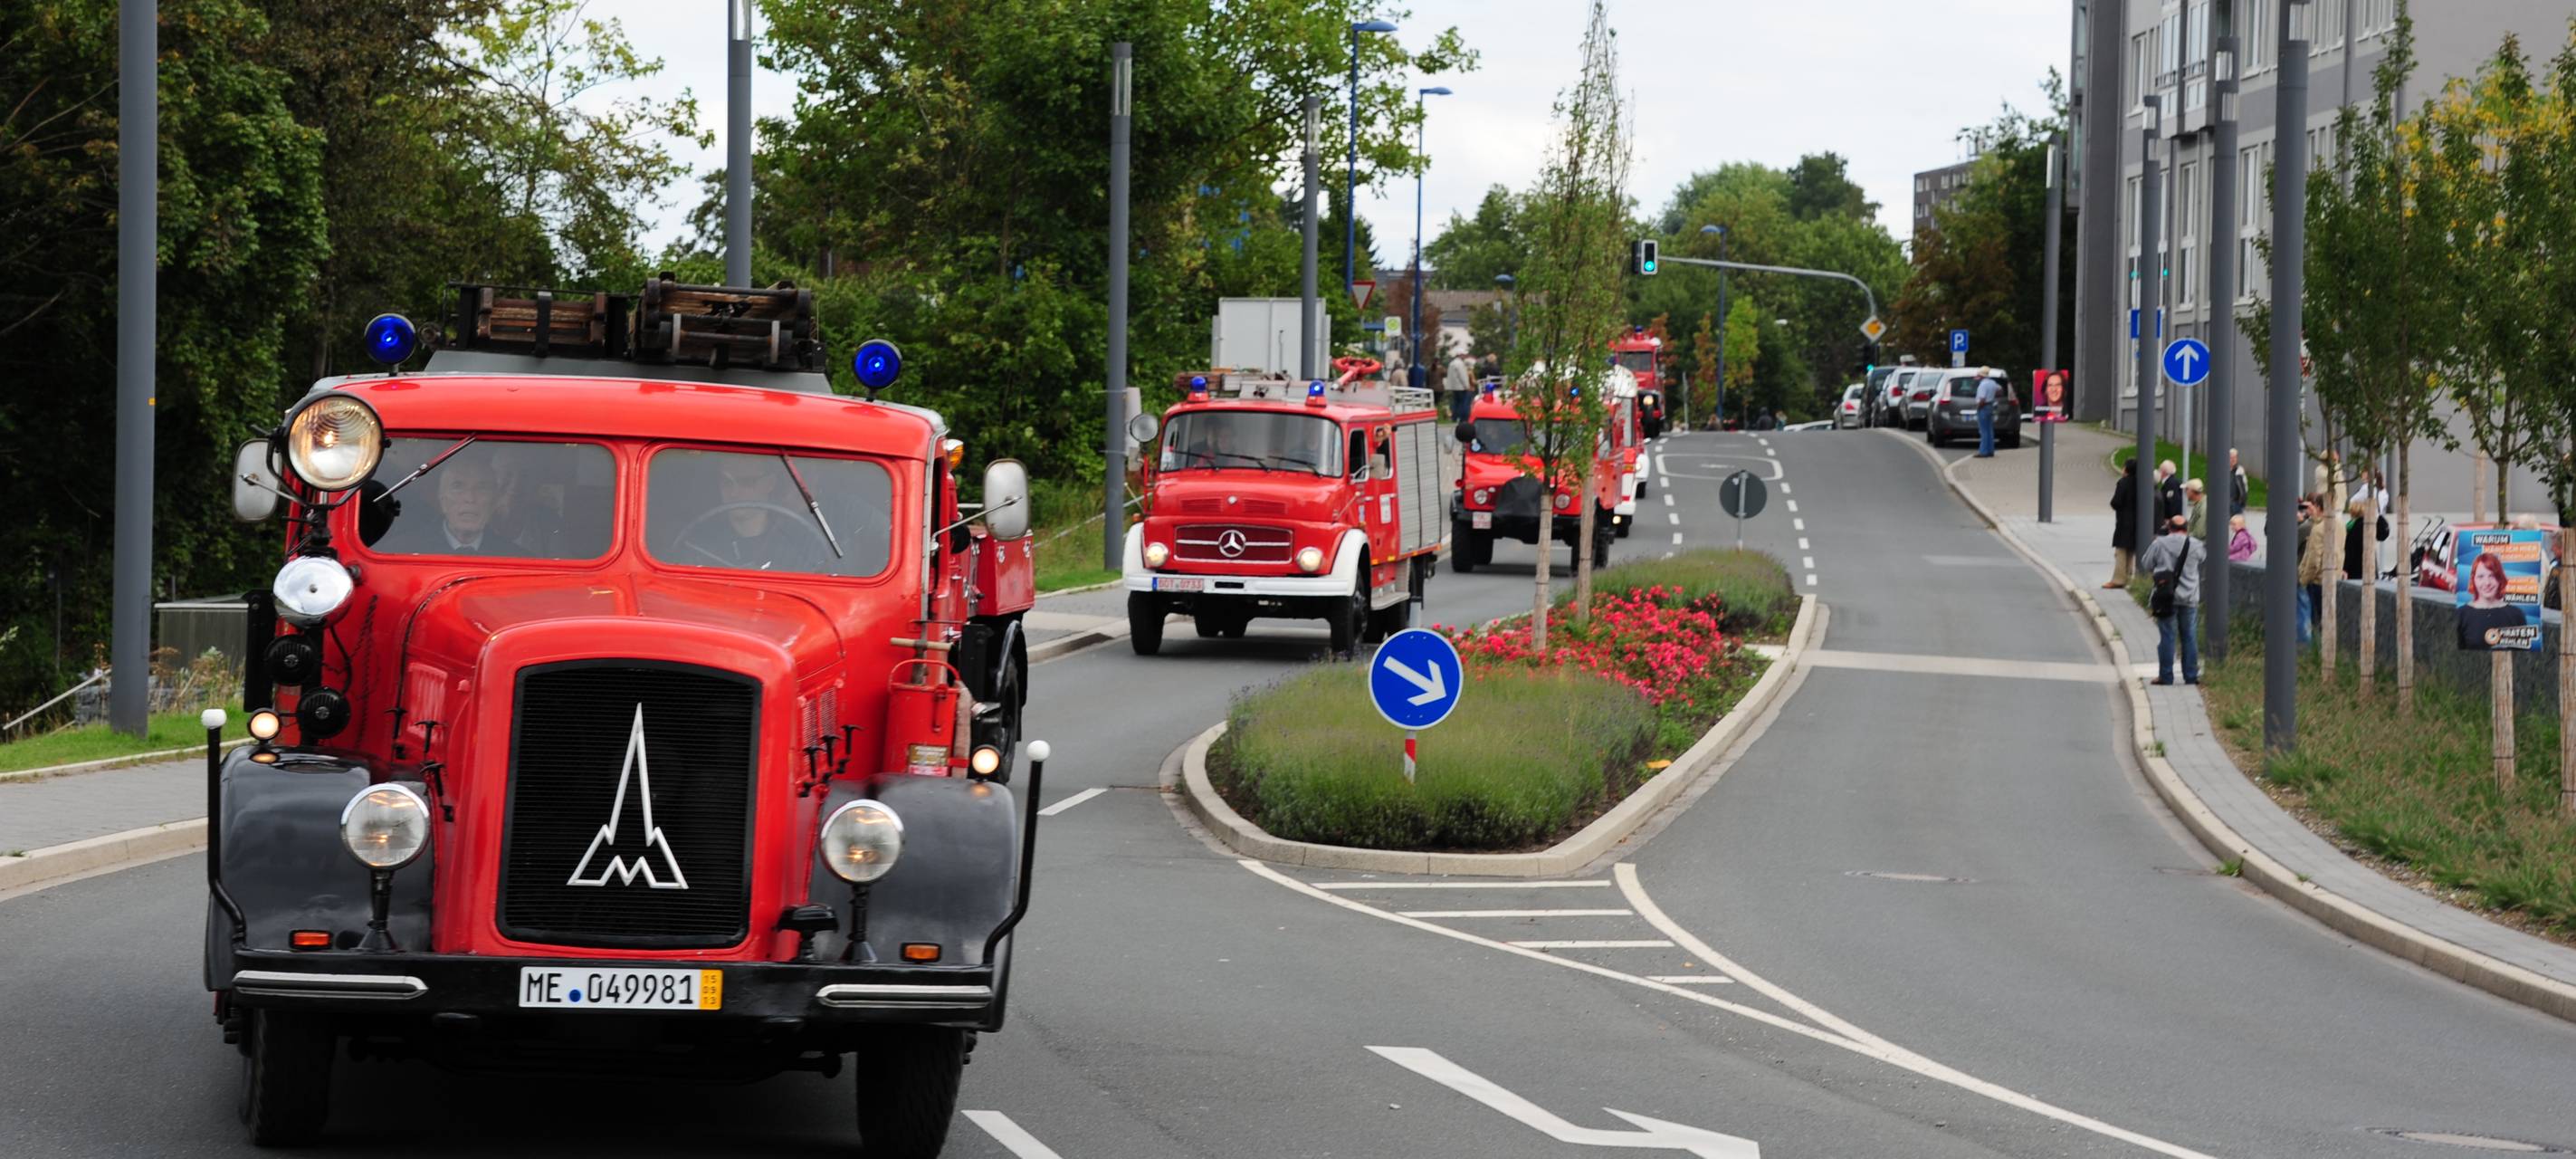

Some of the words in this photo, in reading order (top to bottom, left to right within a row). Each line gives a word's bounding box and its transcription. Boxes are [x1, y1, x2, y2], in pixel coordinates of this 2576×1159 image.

[1954, 333, 1964, 350] P
[2476, 535, 2508, 543] WARUM
[527, 973, 562, 1002] ME
[588, 973, 693, 1004] 049981
